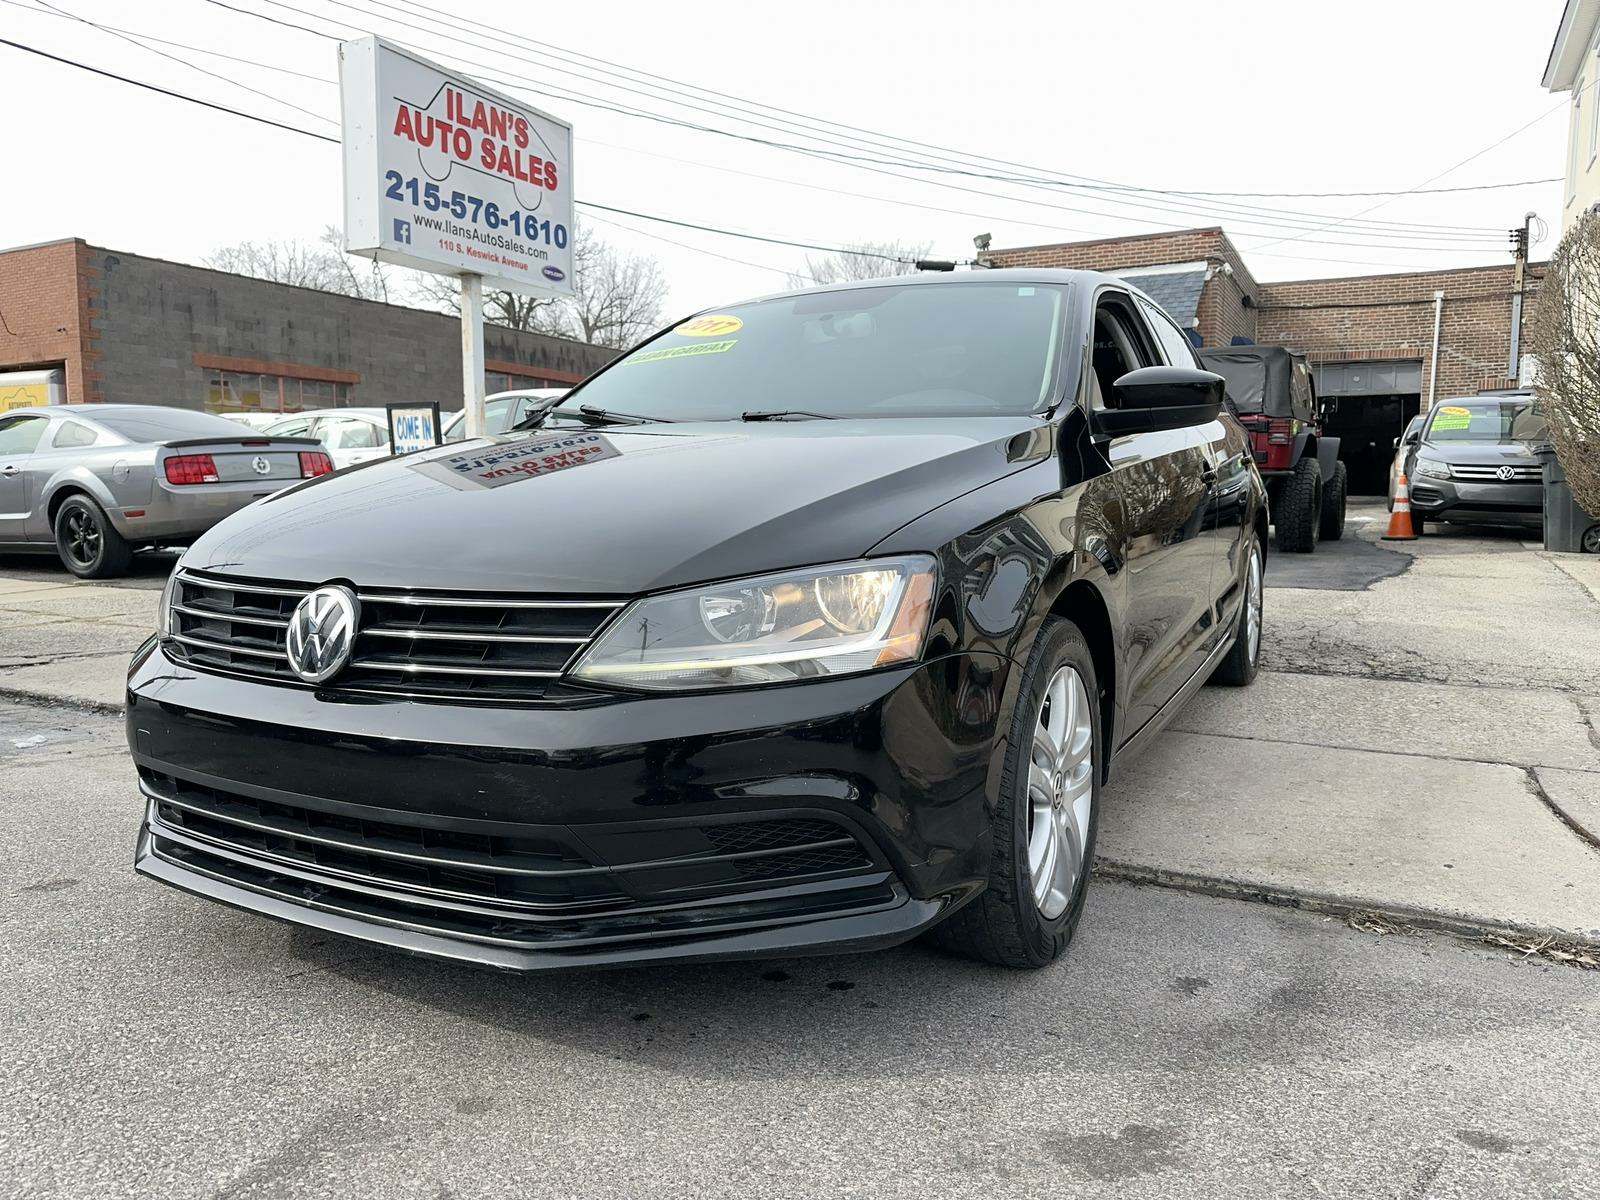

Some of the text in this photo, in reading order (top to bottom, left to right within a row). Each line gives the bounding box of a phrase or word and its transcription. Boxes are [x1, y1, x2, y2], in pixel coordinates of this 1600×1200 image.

[446, 88, 530, 149] ILAN'S
[393, 104, 559, 192] AUTO SALES
[385, 169, 568, 250] 215-576-1610
[413, 213, 549, 261] www.IlansAutoSales.com
[438, 238, 529, 271] 110 S. Keswick Avenue
[397, 415, 432, 440] COME IN
